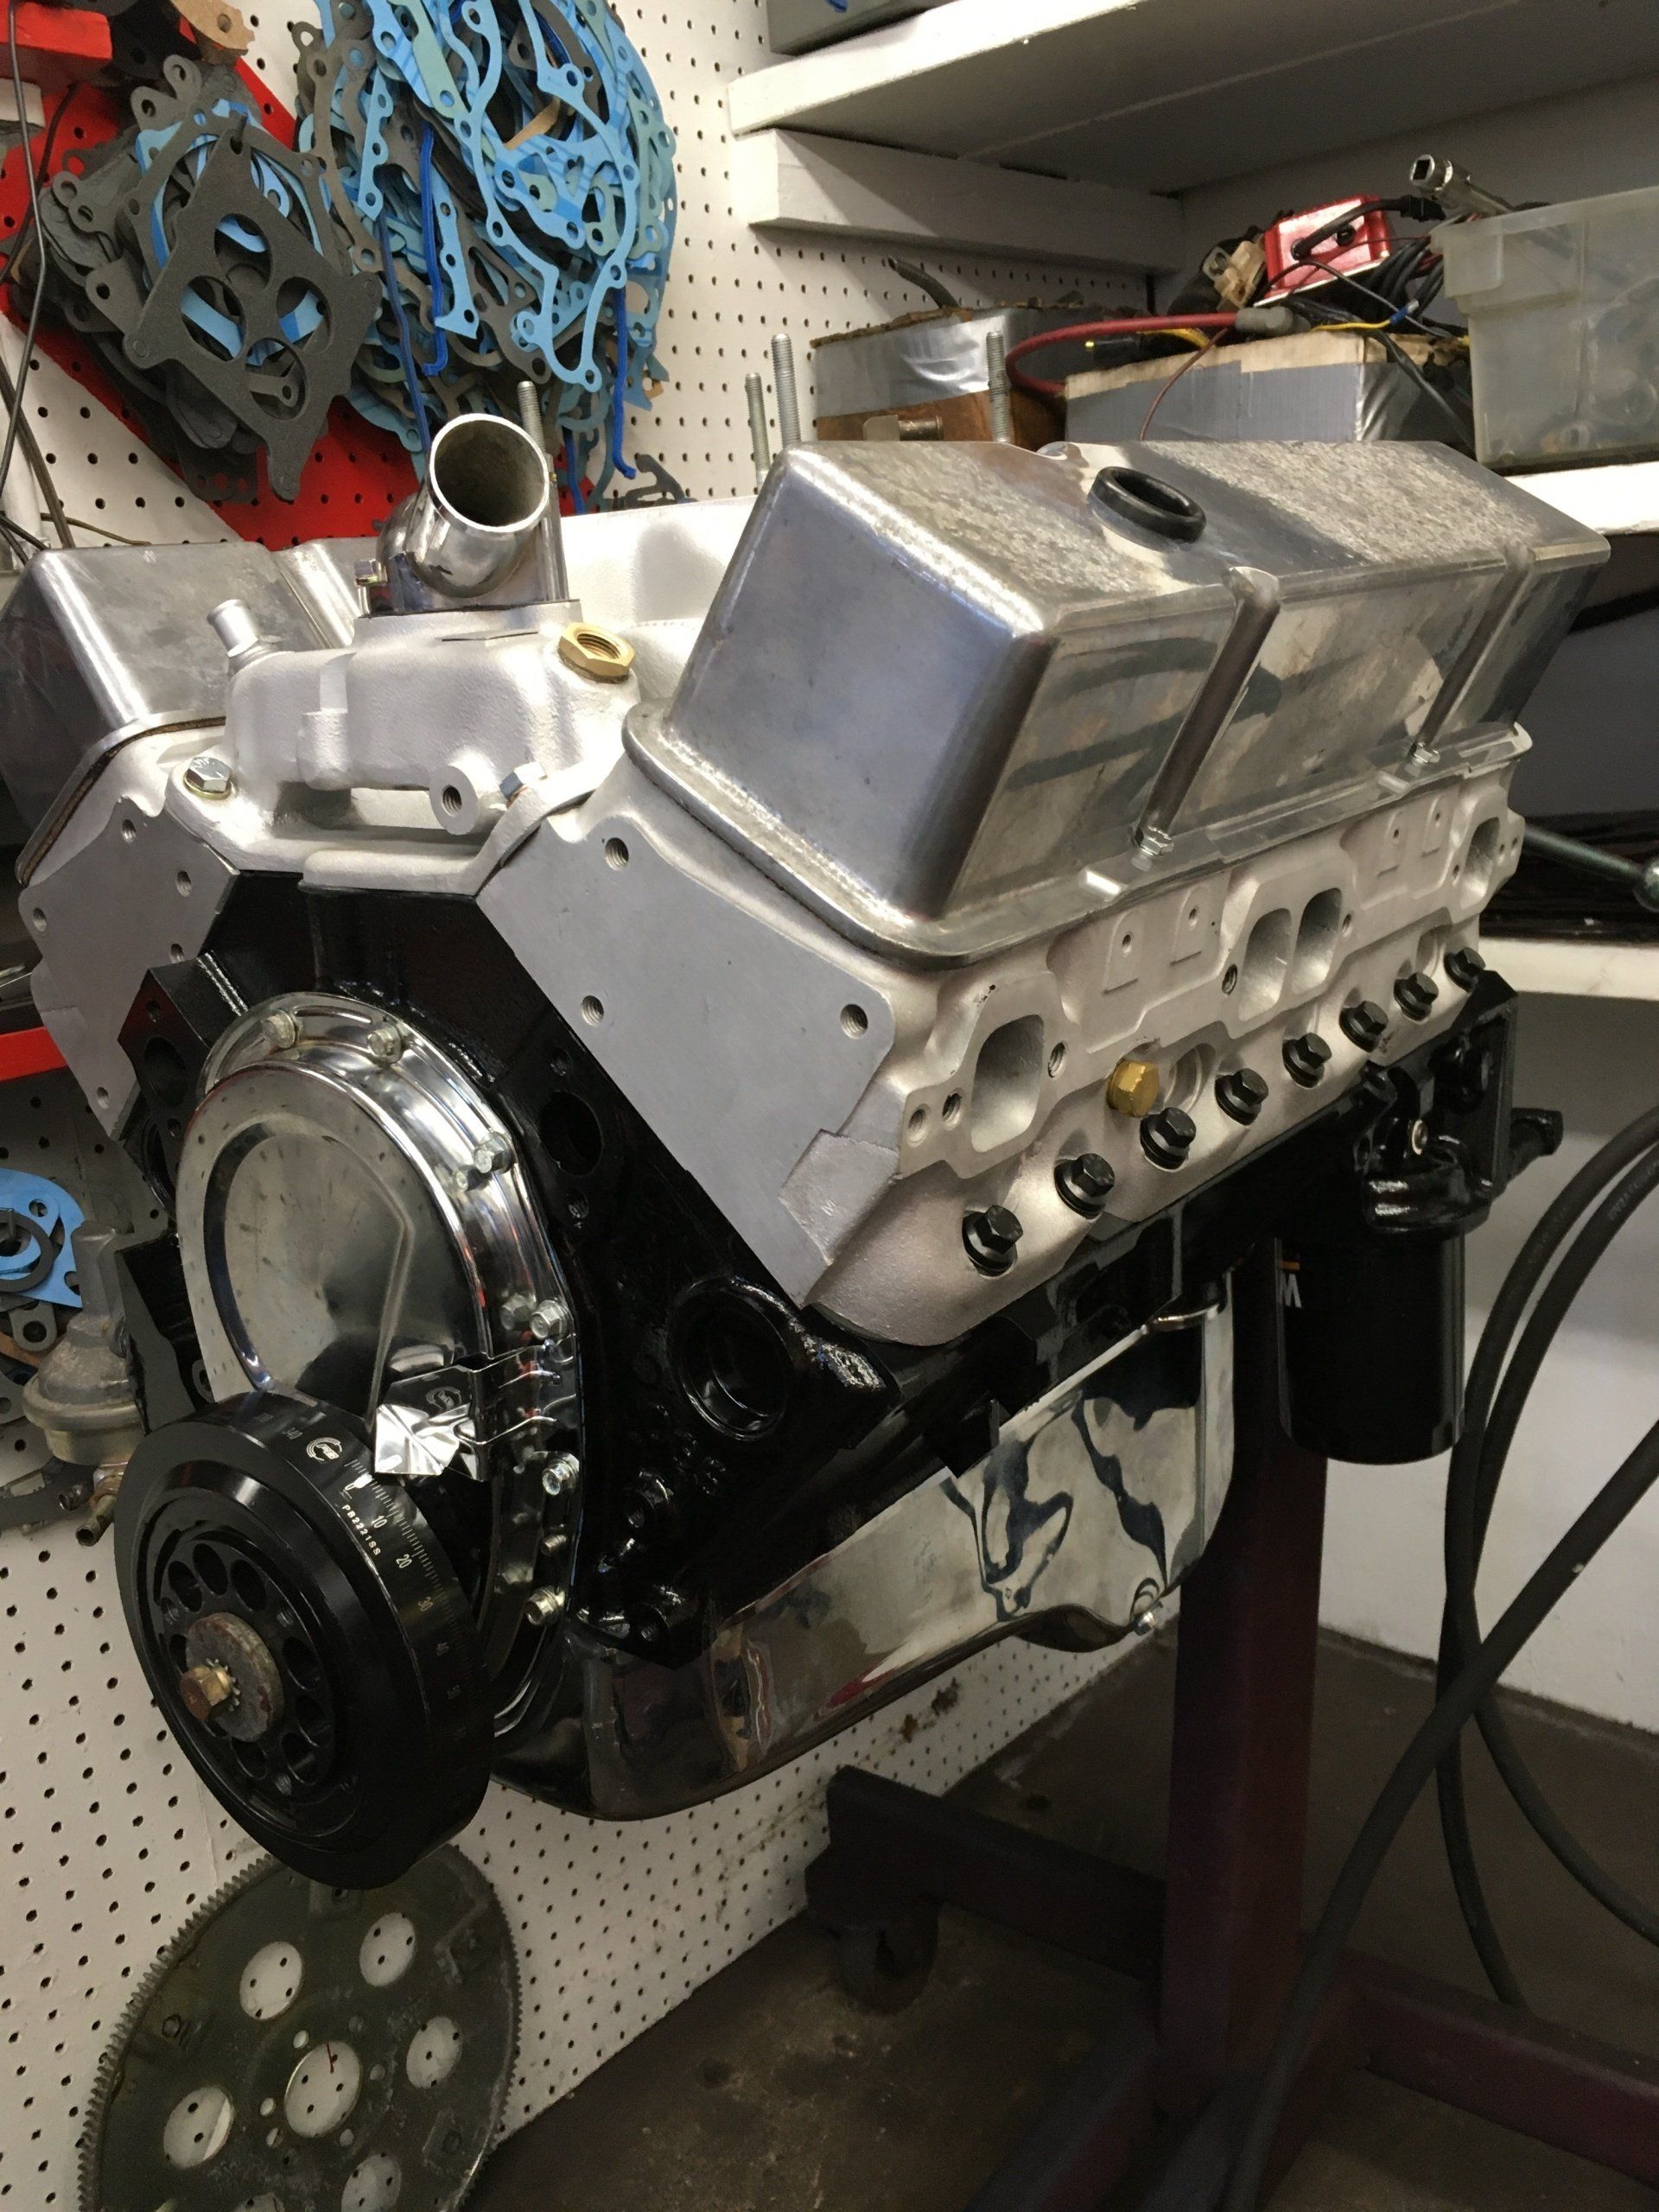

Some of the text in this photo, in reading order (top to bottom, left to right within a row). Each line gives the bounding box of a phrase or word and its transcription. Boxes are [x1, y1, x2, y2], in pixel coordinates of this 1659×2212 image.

[371, 1515, 388, 1529] 10
[342, 1504, 381, 1556] PB2221SS
[395, 1554, 413, 1568] 20
[417, 1597, 434, 1611] 30
